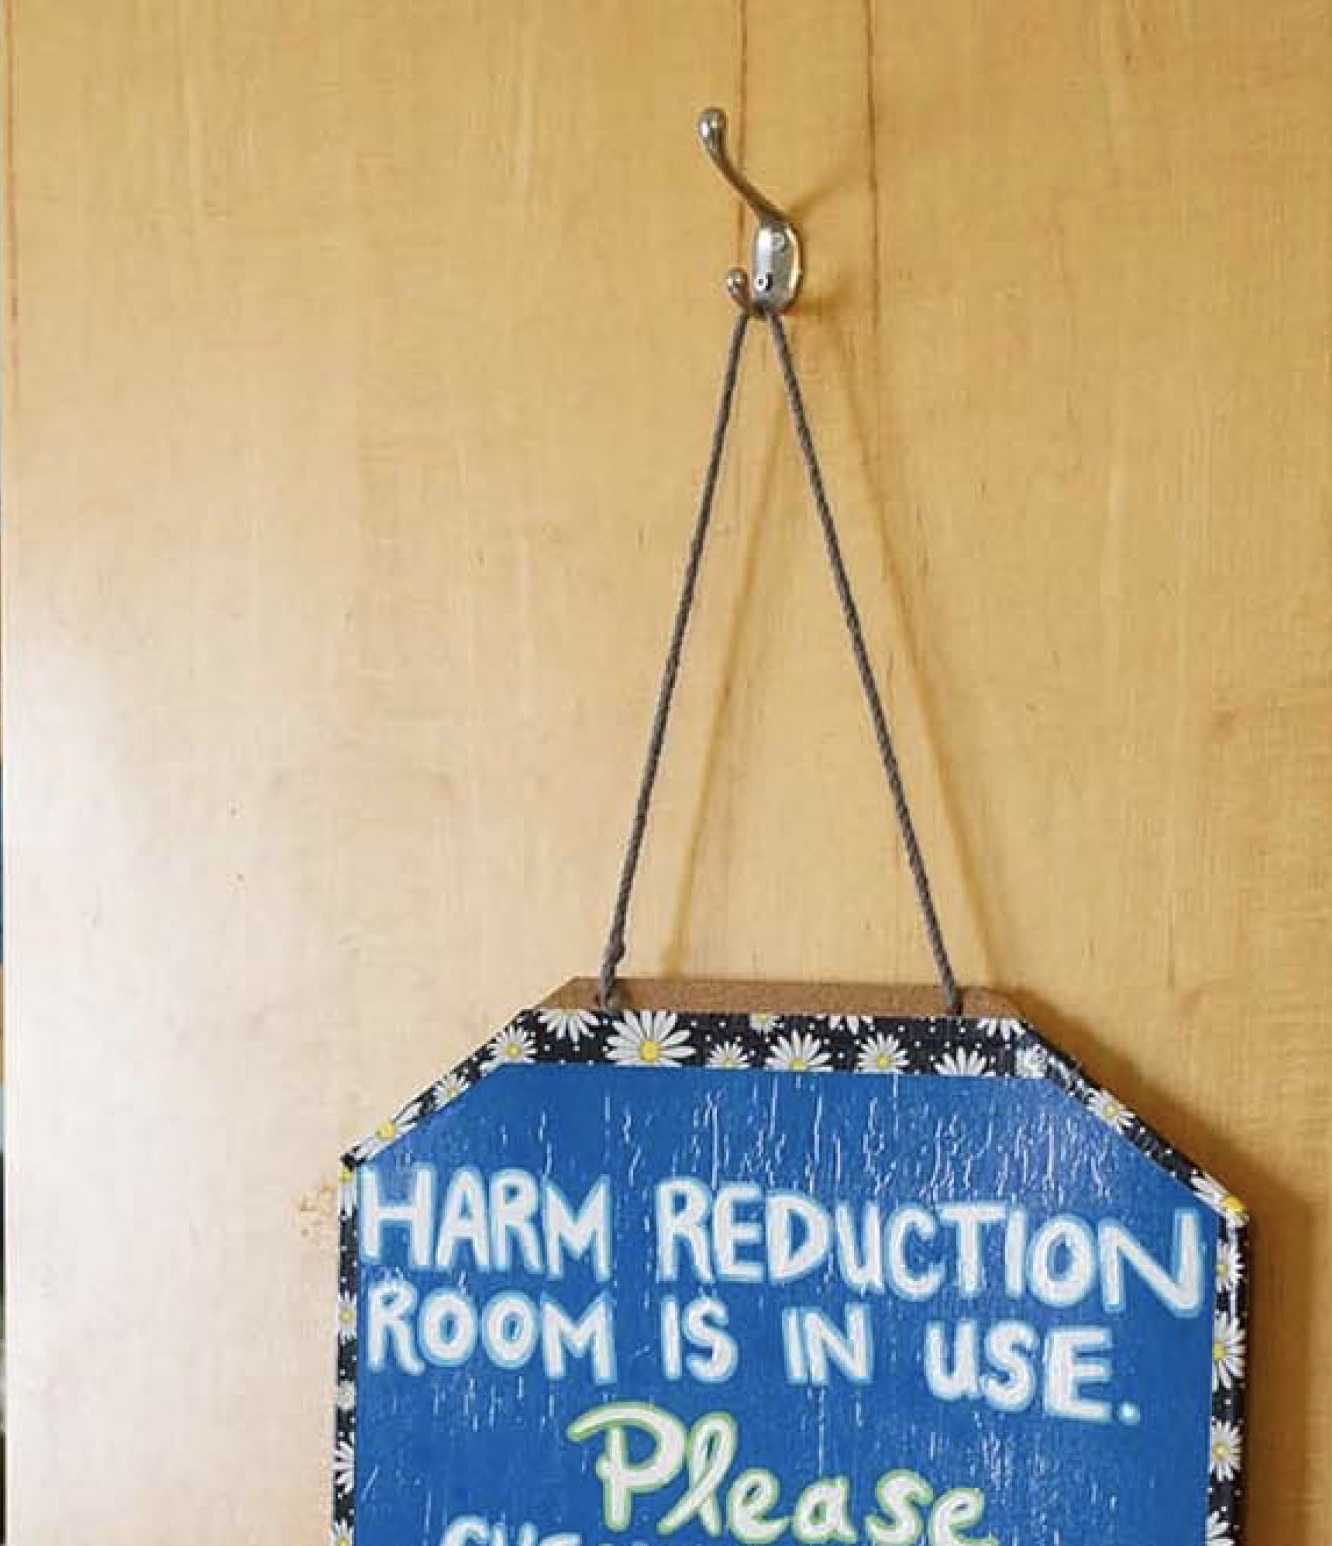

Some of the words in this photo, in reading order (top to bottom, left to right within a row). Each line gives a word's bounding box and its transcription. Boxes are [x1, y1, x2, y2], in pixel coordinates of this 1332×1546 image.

[358, 1164, 611, 1280] HARM
[654, 1178, 1204, 1314] REDUCTION
[365, 1272, 616, 1382] ROOM
[660, 1294, 739, 1383] IS
[782, 1304, 871, 1386] IN
[924, 1319, 1142, 1426] USE.
